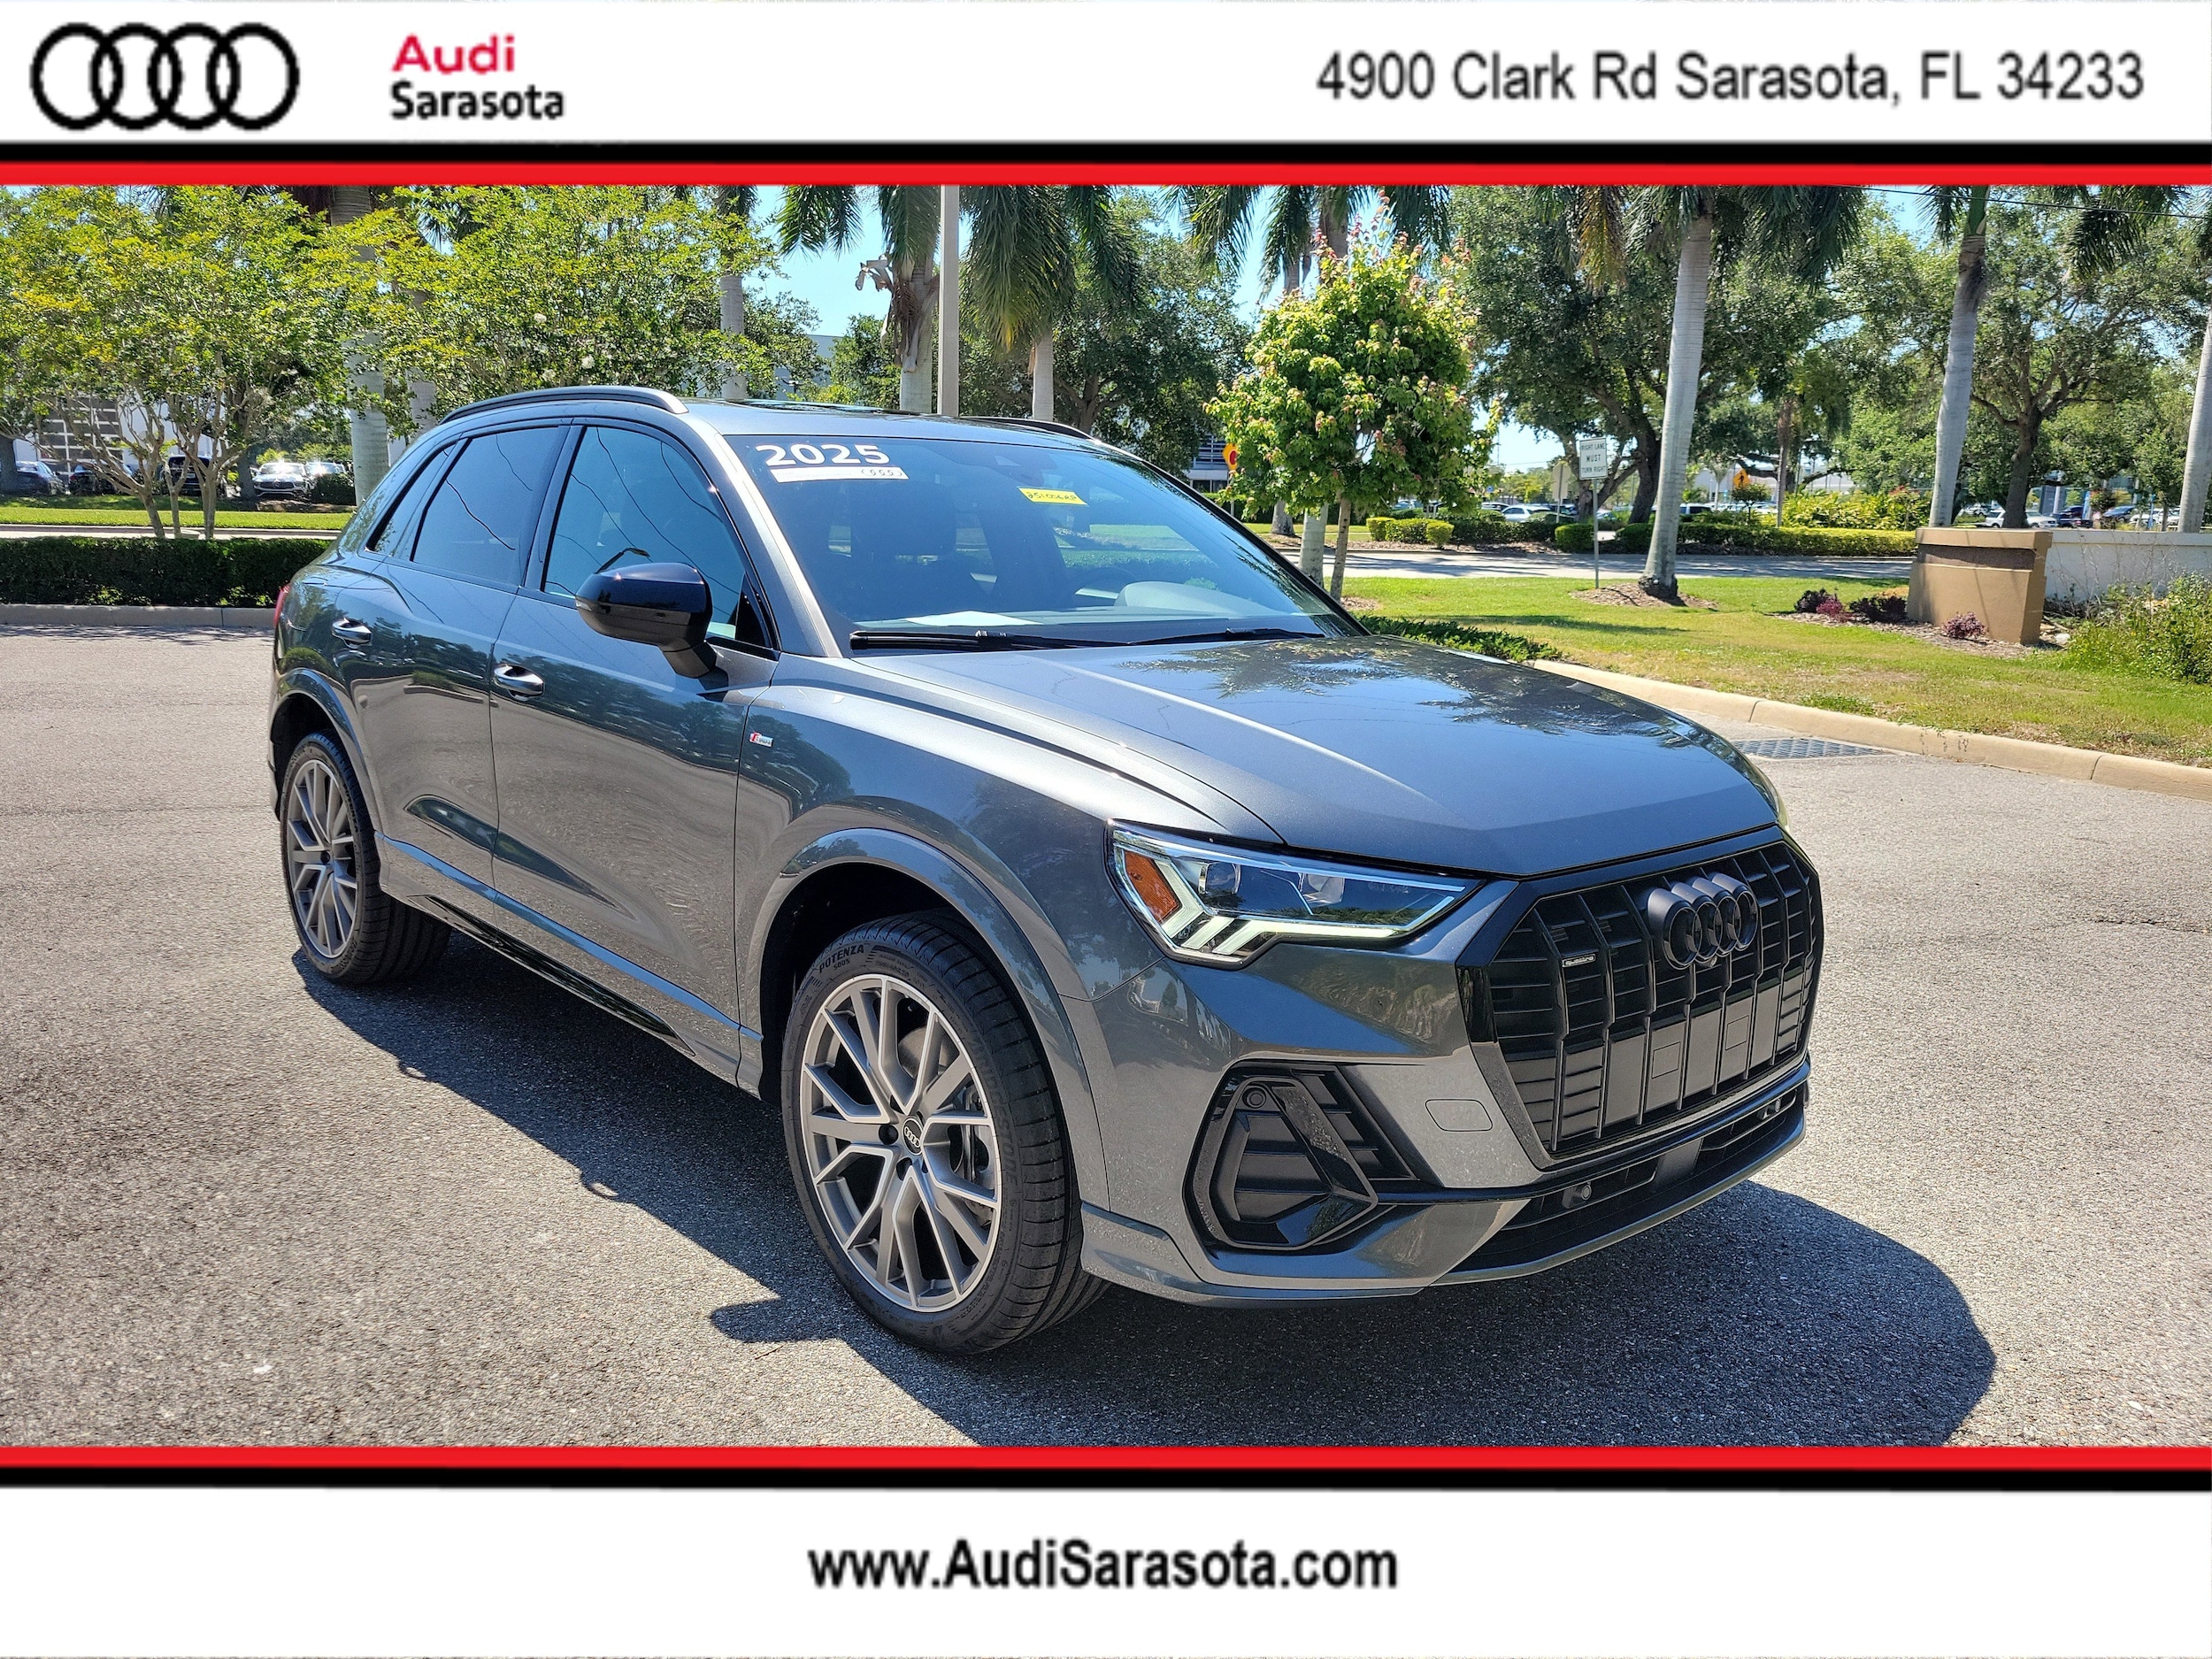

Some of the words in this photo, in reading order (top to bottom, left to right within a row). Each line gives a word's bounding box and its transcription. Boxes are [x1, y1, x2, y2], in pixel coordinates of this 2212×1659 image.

[755, 443, 890, 466] 2025
[1586, 454, 1601, 463] MUST
[819, 944, 864, 973] POTENZA
